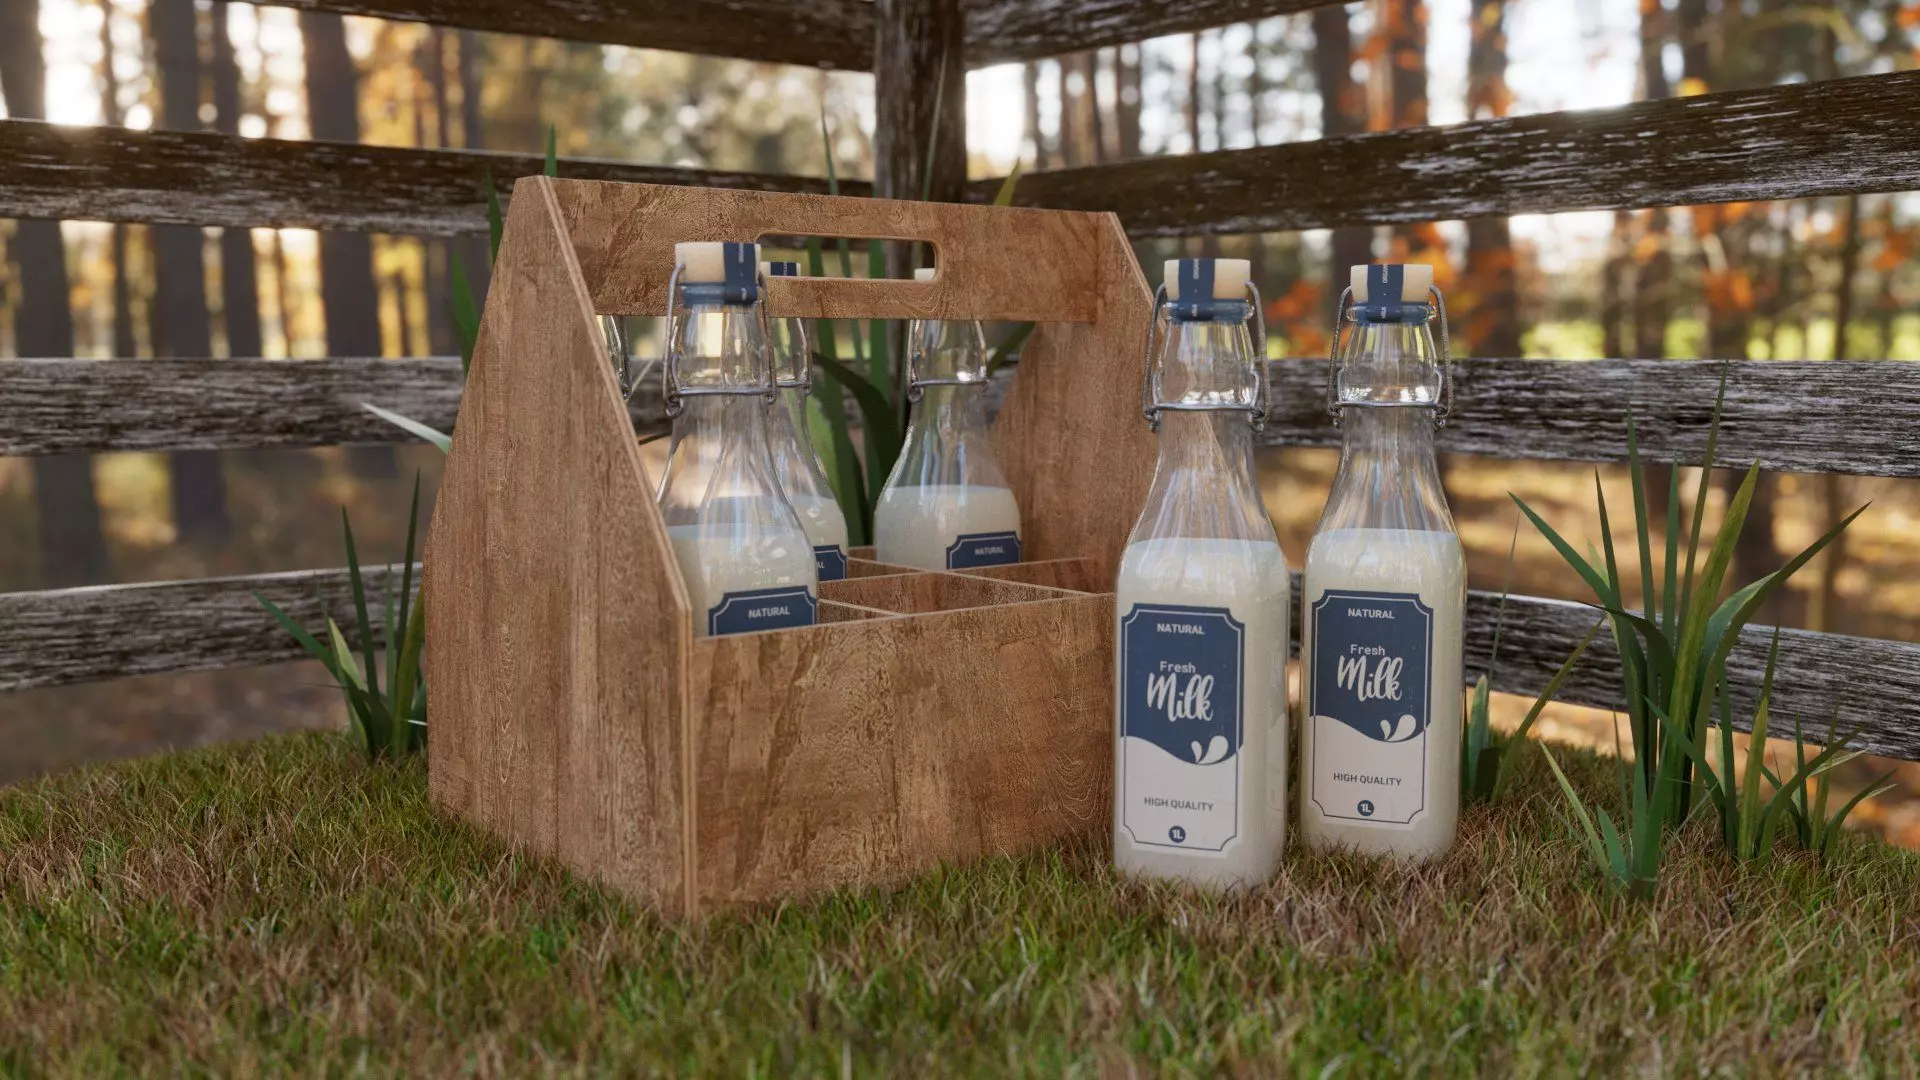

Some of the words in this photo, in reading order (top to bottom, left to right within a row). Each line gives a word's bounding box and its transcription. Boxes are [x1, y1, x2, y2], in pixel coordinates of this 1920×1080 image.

[974, 546, 1005, 556] NATURAL
[748, 605, 790, 619] NATURAL
[1347, 608, 1395, 619] NATURAL
[1156, 623, 1205, 635] NATURAL
[1350, 644, 1386, 656] Fresh
[1160, 661, 1196, 673] Fresh
[1337, 654, 1404, 702] Milk
[1146, 672, 1214, 722] Milk
[1333, 772, 1358, 783] HIGH
[1360, 775, 1402, 786] QUALITY
[1143, 797, 1169, 807] HIGH
[1170, 800, 1214, 812] QUALITY
[1360, 803, 1372, 813] 1L
[1171, 829, 1183, 840] 1L
